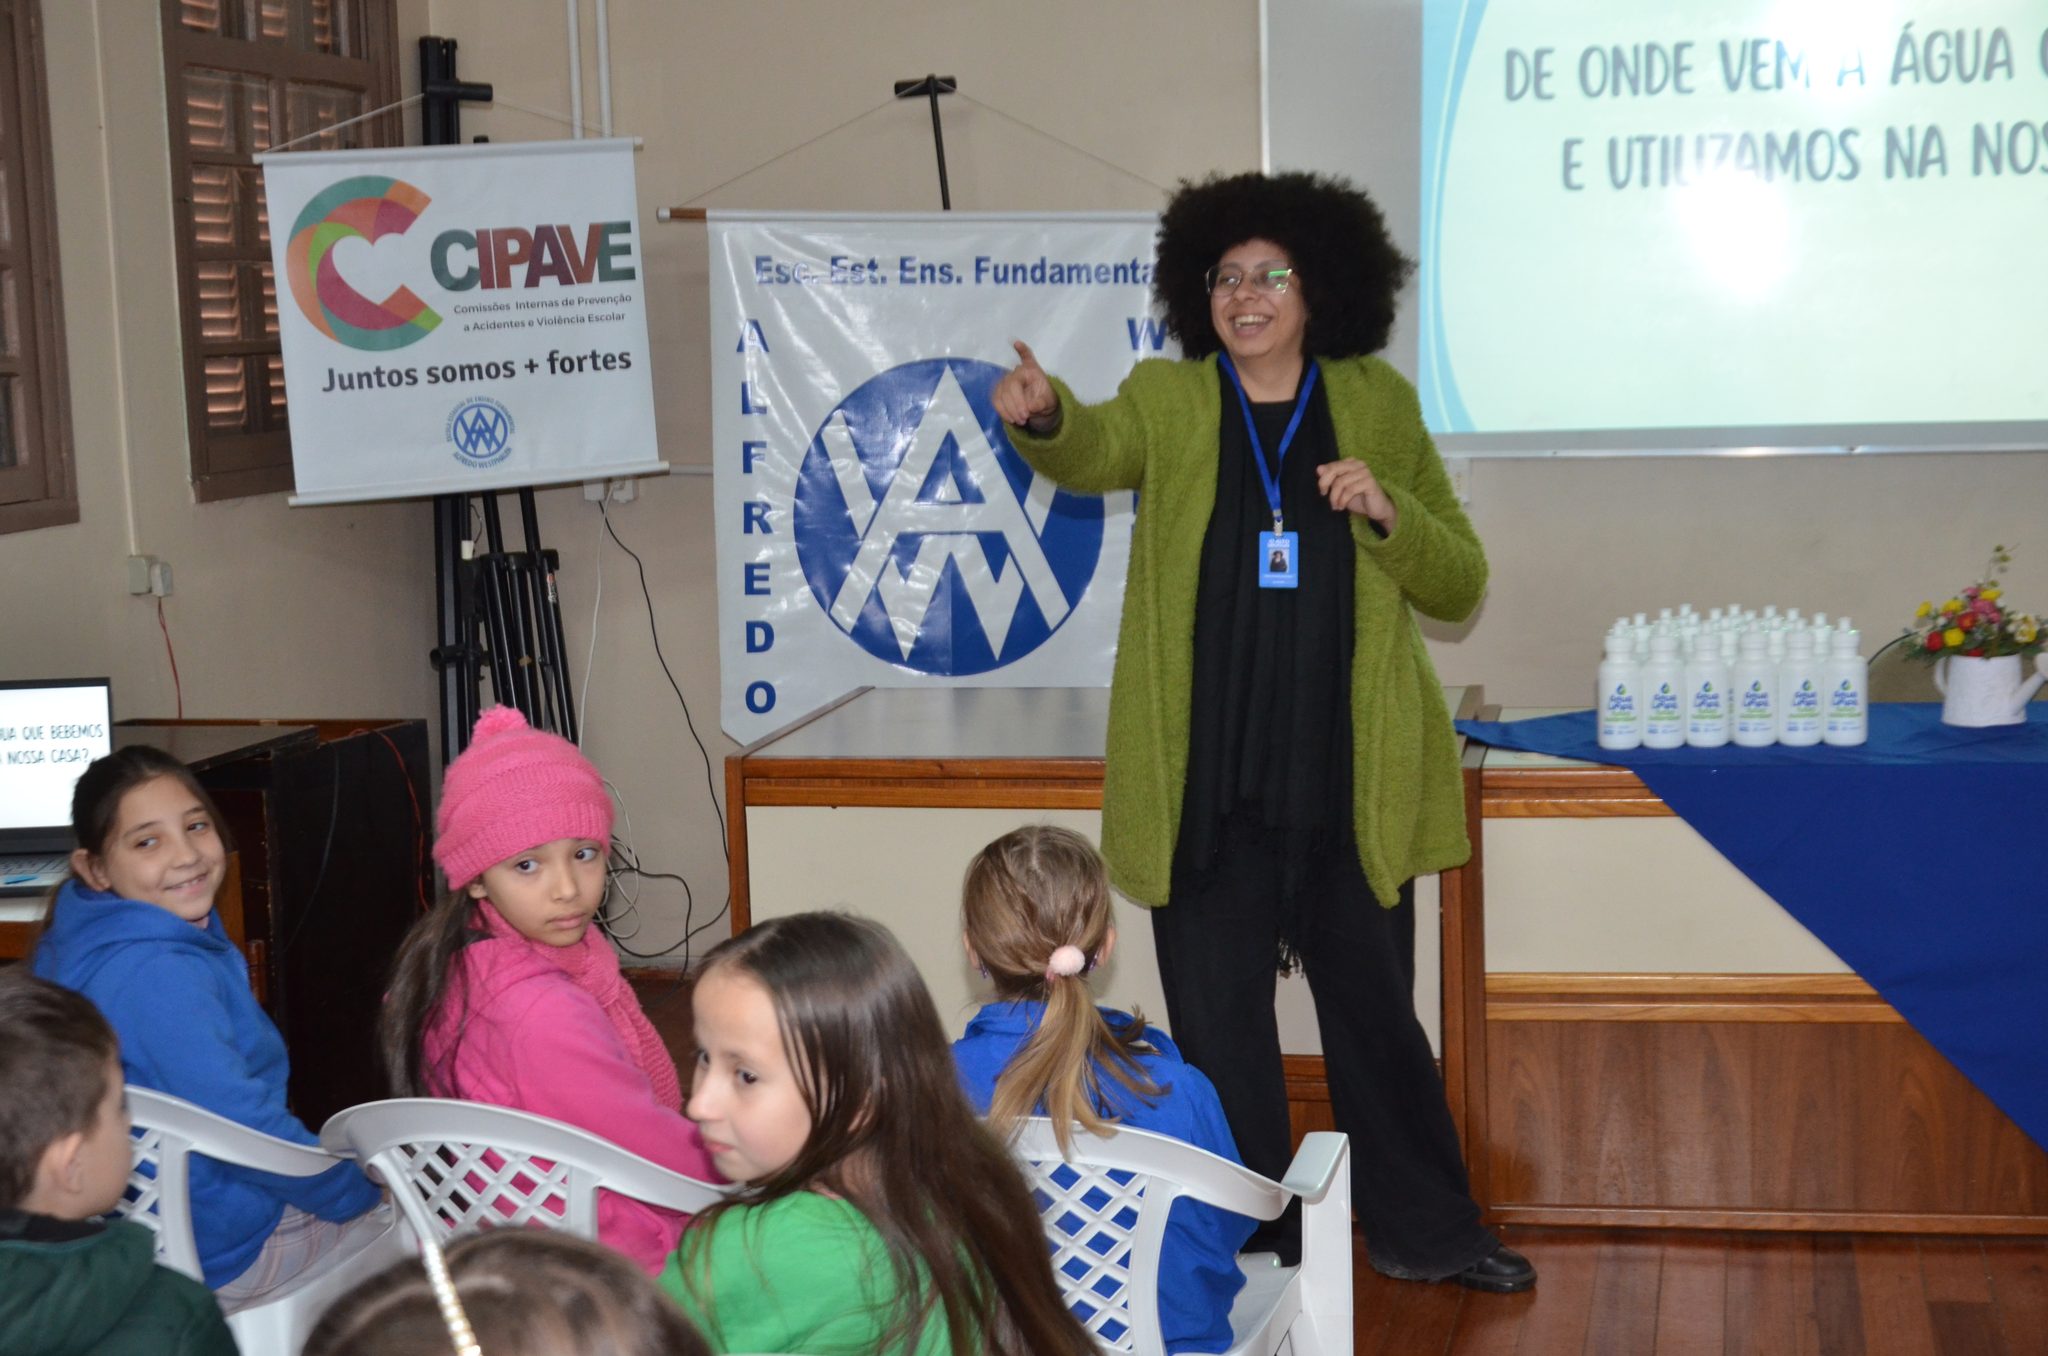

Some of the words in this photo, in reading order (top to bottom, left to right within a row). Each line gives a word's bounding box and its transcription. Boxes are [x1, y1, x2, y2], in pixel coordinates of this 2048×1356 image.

[1504, 46, 1556, 102] DE
[1578, 41, 1696, 99] ONDE
[1719, 38, 1811, 92] VEM
[1890, 20, 2015, 86] ÁGUA
[1561, 137, 1586, 191] E
[1885, 123, 1949, 180] NA
[430, 220, 637, 293] CIPAVE
[830, 255, 888, 285] Est.
[900, 255, 963, 285] Ens.
[974, 255, 1157, 285] Fundamenta
[453, 302, 511, 315] Comissões
[515, 299, 560, 311] Internas
[561, 297, 575, 307] de
[577, 293, 633, 306] Prevenção
[463, 323, 470, 332] a
[472, 319, 526, 332] Acidentes
[528, 319, 535, 328] e
[536, 314, 586, 328] Violência
[587, 311, 627, 324] Escolar
[322, 364, 419, 393] Juntos
[426, 359, 517, 385] somos
[546, 349, 633, 375] fortes
[22, 726, 44, 741] QUE
[50, 723, 104, 740] BEBEMOS
[7, 750, 45, 765] NOSSA
[51, 747, 89, 764] CASA?
